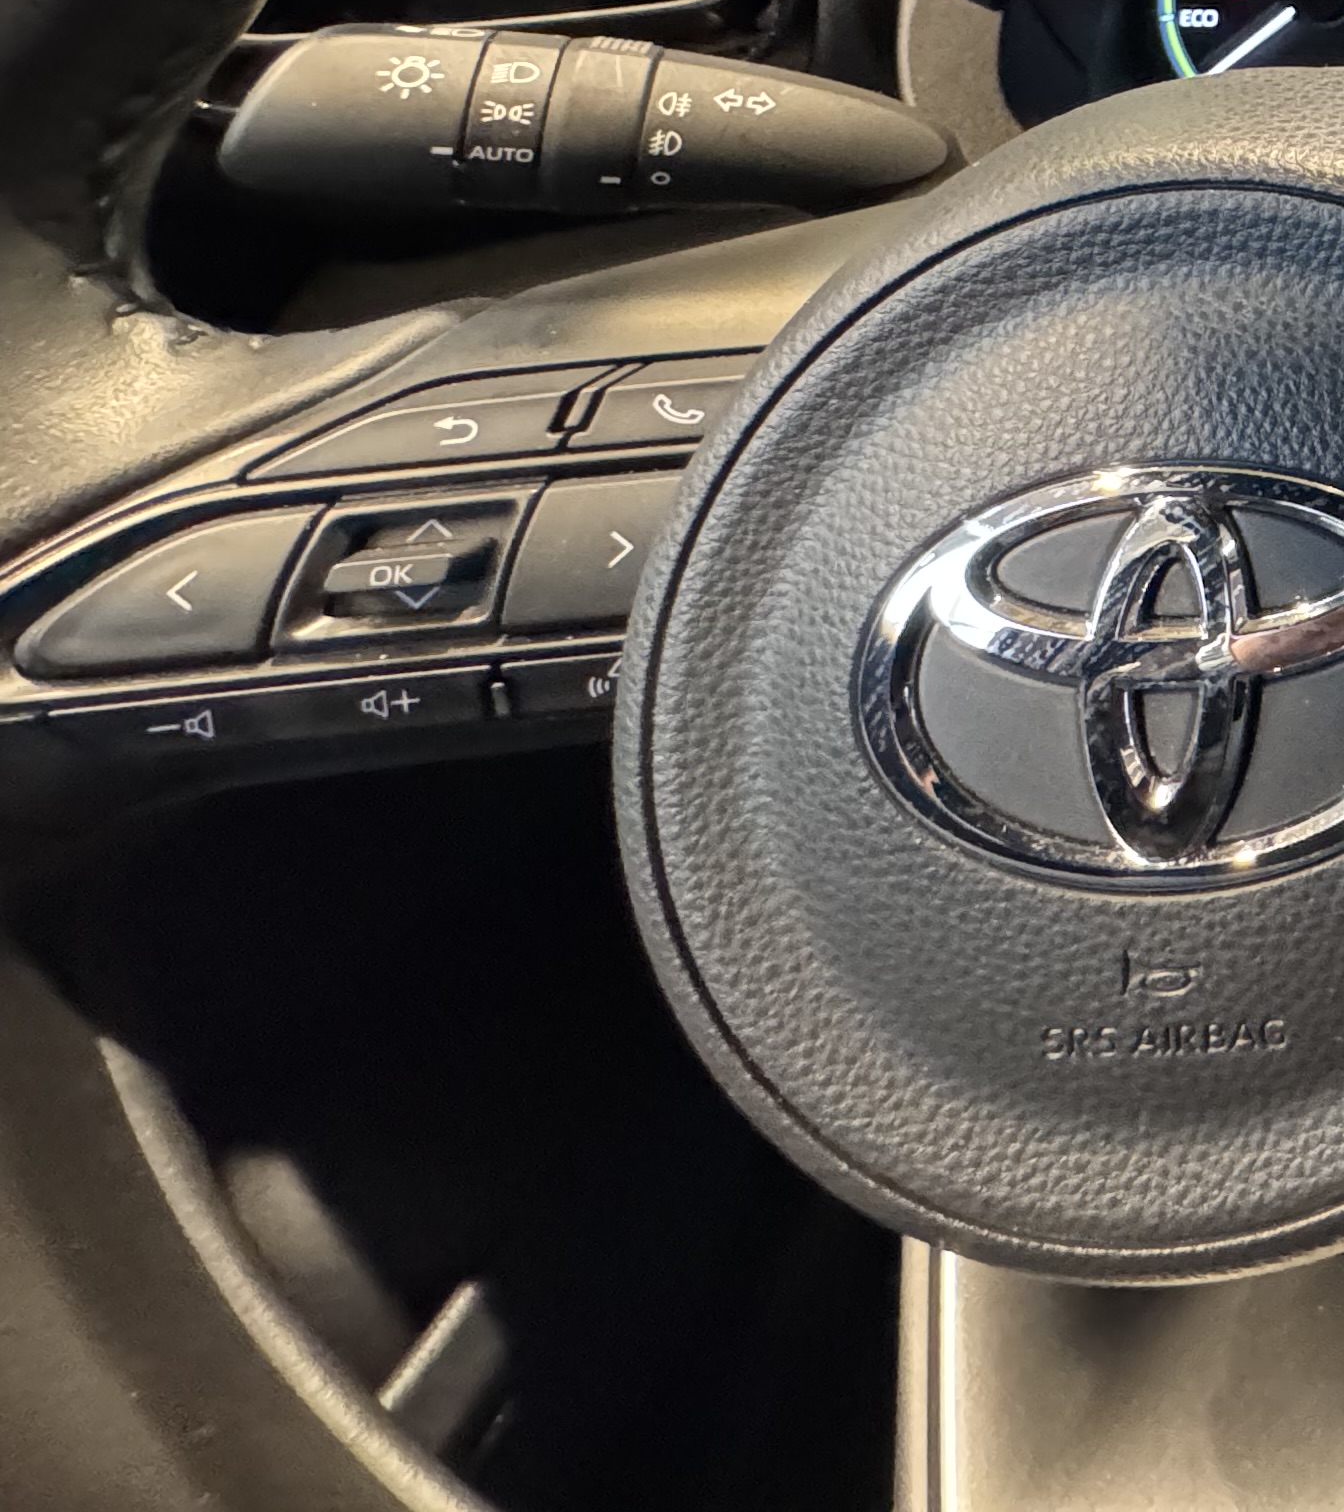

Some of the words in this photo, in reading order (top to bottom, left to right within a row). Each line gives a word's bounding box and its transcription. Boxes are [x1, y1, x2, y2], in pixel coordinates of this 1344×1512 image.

[1179, 9, 1218, 28] ECO
[468, 145, 534, 164] AUTO
[369, 562, 415, 587] OK
[1041, 1026, 1118, 1060] SRS
[1131, 1018, 1287, 1058] AIRBAG
